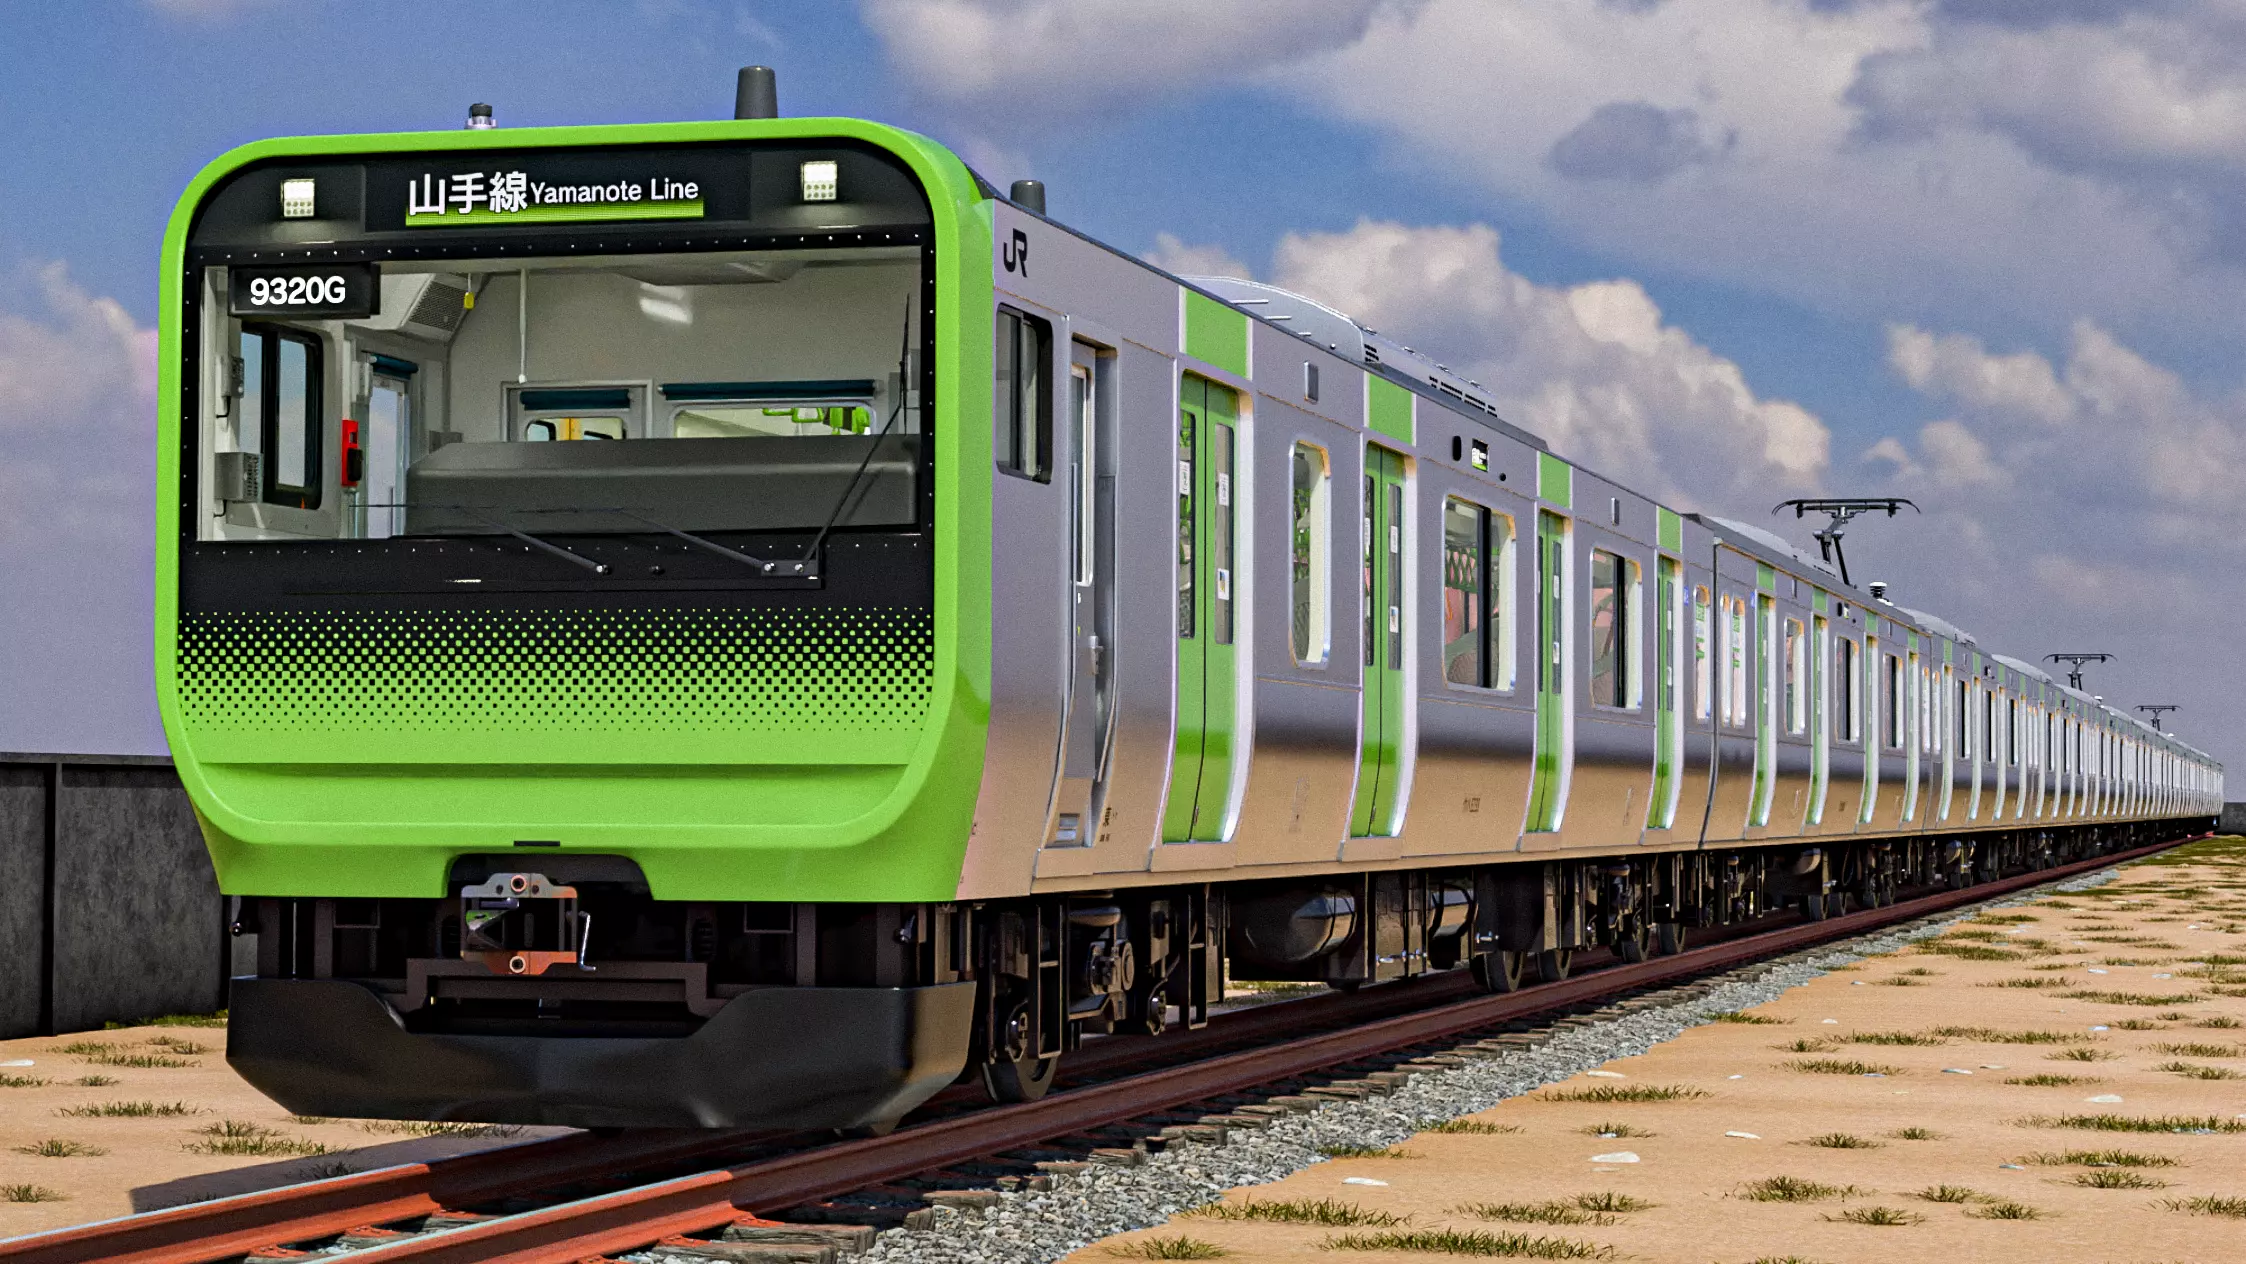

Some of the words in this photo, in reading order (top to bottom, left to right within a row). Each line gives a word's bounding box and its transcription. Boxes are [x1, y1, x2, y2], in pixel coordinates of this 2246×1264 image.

[409, 171, 528, 216] 山手線
[530, 180, 642, 205] Yamanote
[650, 177, 699, 201] Line
[1003, 227, 1028, 278] JR
[250, 275, 346, 306] 9320G
